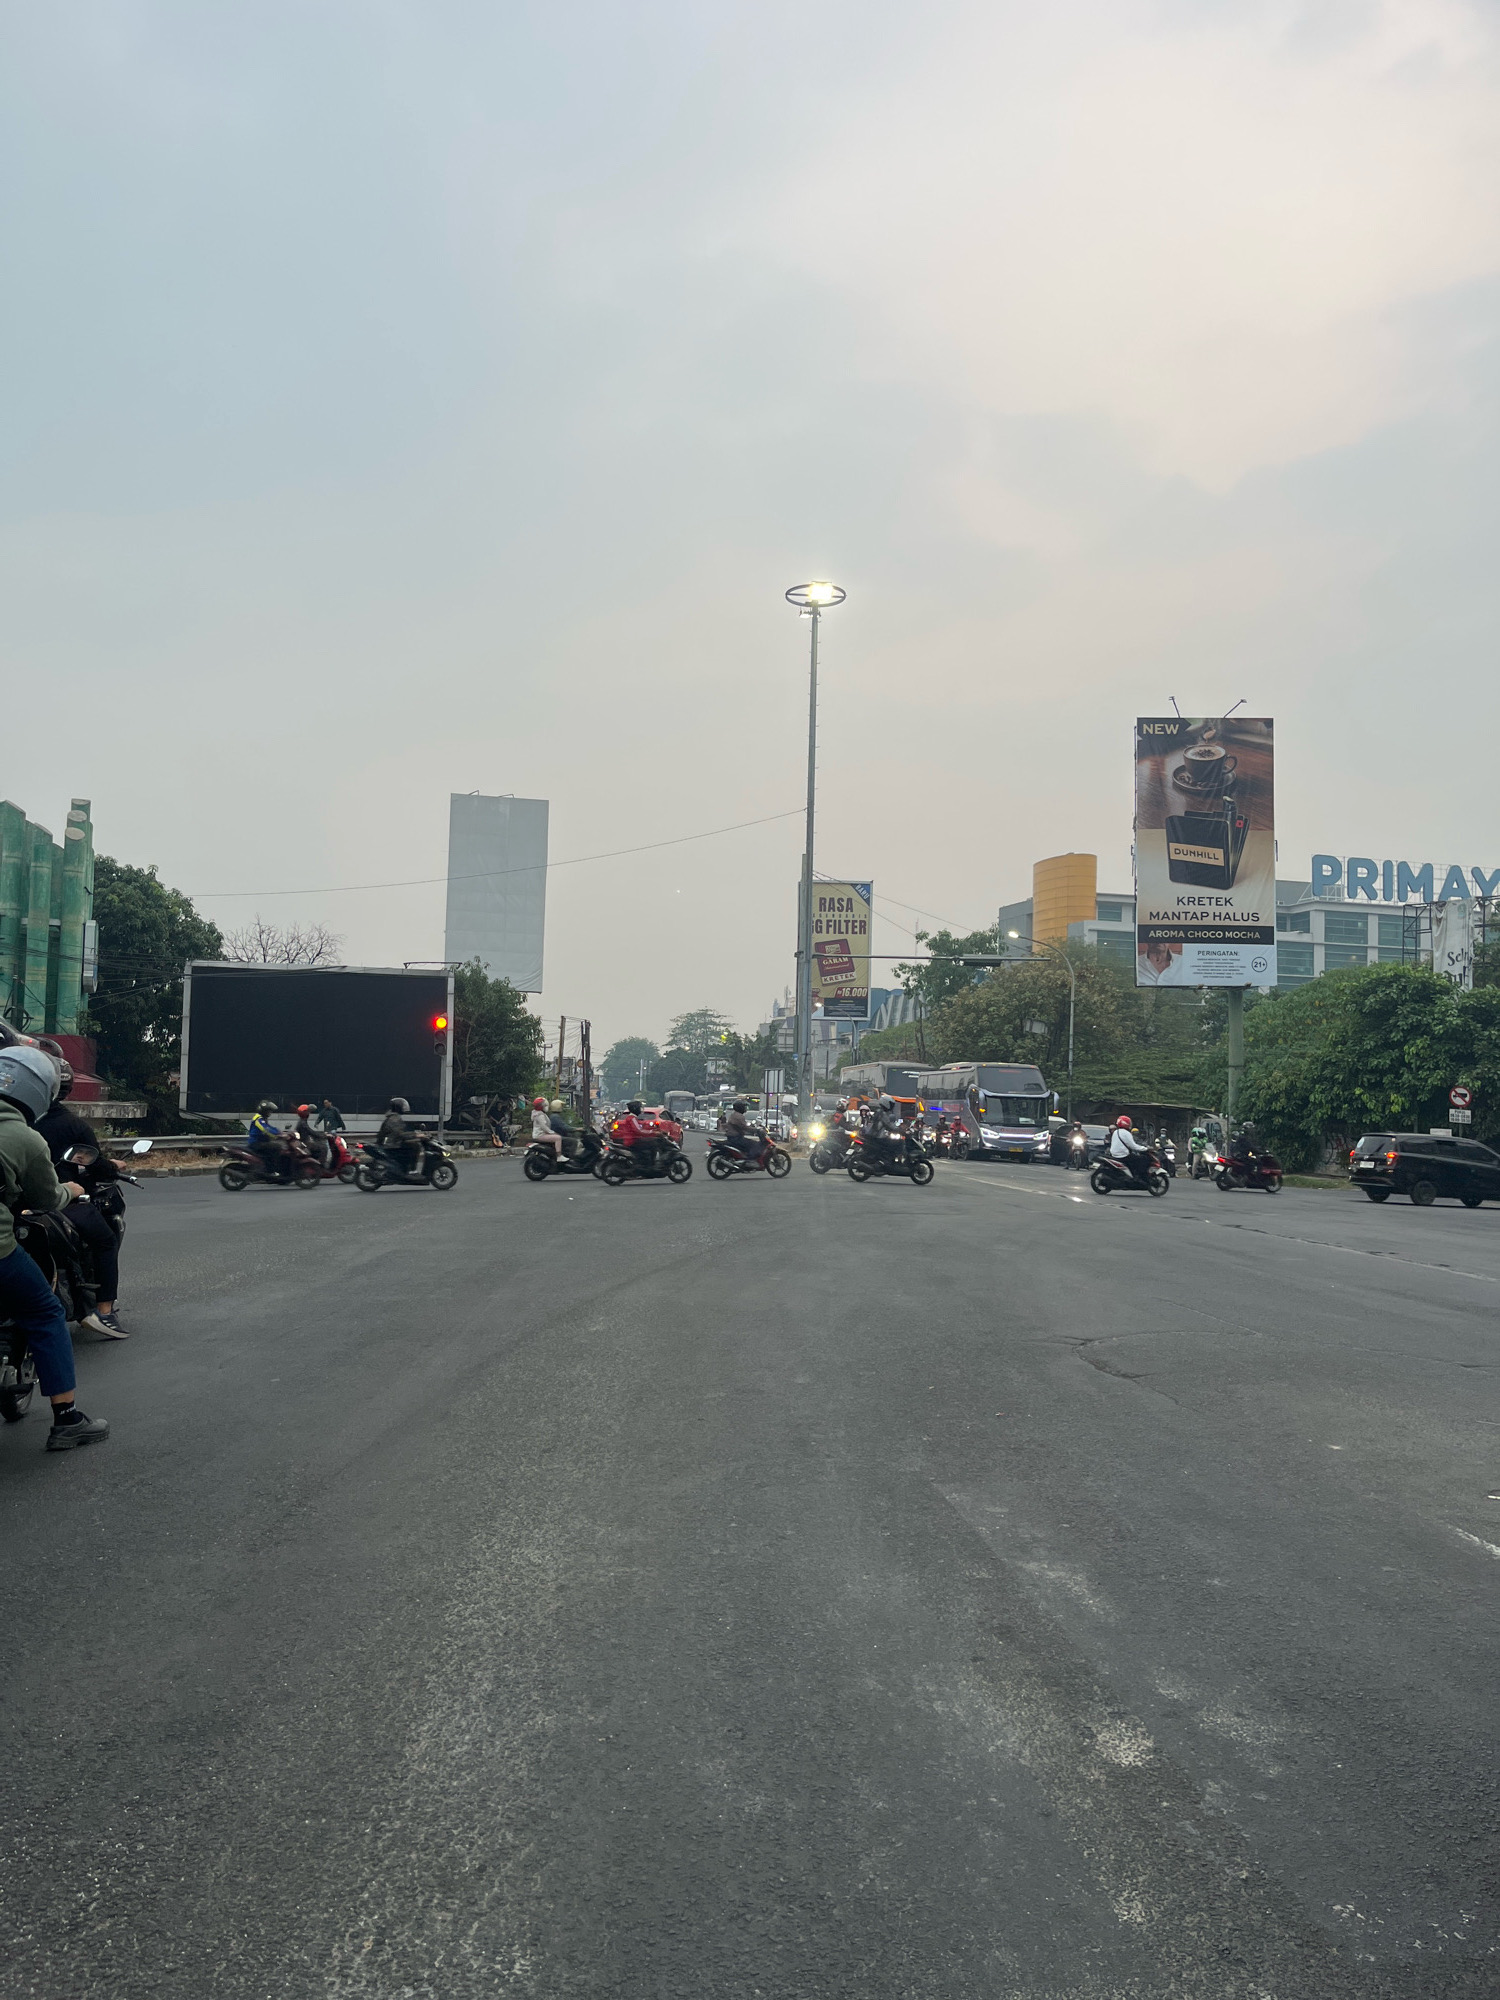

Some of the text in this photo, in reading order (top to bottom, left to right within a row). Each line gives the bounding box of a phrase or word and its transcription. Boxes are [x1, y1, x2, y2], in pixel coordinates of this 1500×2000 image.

[1142, 723, 1179, 735] NEW
[1174, 848, 1220, 861] DUNHILL
[818, 896, 854, 913] RASA
[1176, 896, 1234, 907] KRETEK
[1149, 911, 1260, 922] MANTAP HALUS
[825, 919, 867, 935] FILTER
[1148, 930, 1261, 939] AROMA CHOCO MOCHA
[823, 972, 855, 982] KRETEK
